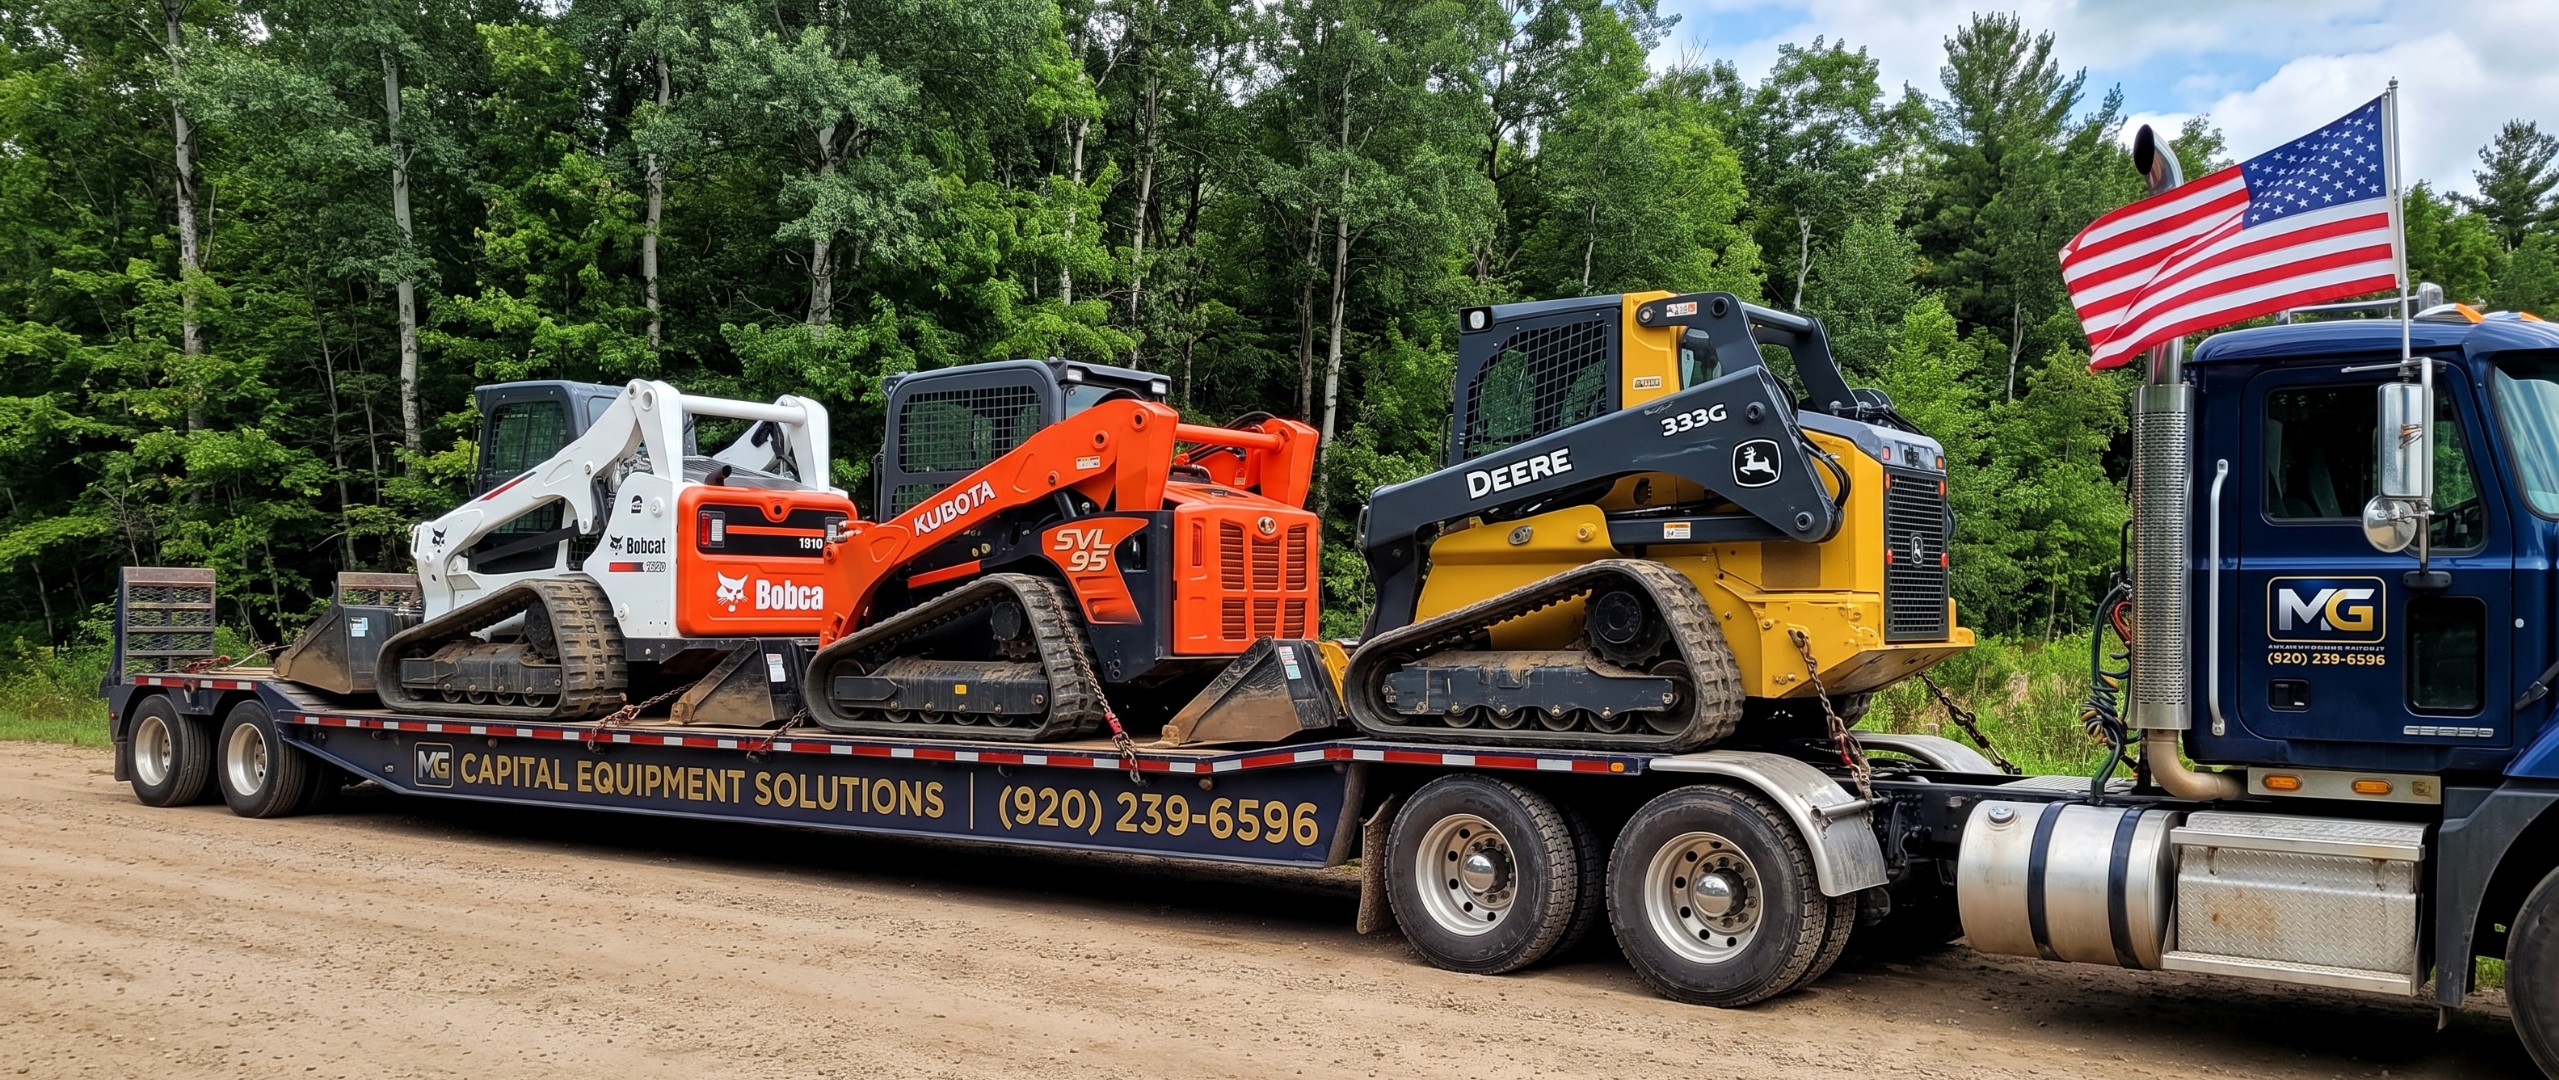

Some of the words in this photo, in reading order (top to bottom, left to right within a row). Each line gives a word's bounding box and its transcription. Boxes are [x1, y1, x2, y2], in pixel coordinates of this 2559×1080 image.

[1661, 404, 1727, 437] 333G
[1467, 447, 1573, 499] DEERE
[913, 480, 996, 537] KUBOTA
[626, 537, 666, 554] Bobcat
[799, 537, 824, 549] 1910
[1053, 528, 1113, 550] SVL
[1066, 550, 1110, 572] 95
[755, 579, 824, 610] Bobca
[2278, 588, 2375, 631] MG
[2267, 652, 2308, 666] (920)
[2312, 653, 2386, 666] 239-6596
[418, 750, 450, 779] MG
[460, 753, 569, 791] CAPITAL
[577, 760, 745, 803] EQUIPMENT
[755, 771, 945, 819] SOLUTIONS
[999, 785, 1102, 836] (920)
[1115, 791, 1319, 846] 239-6596
